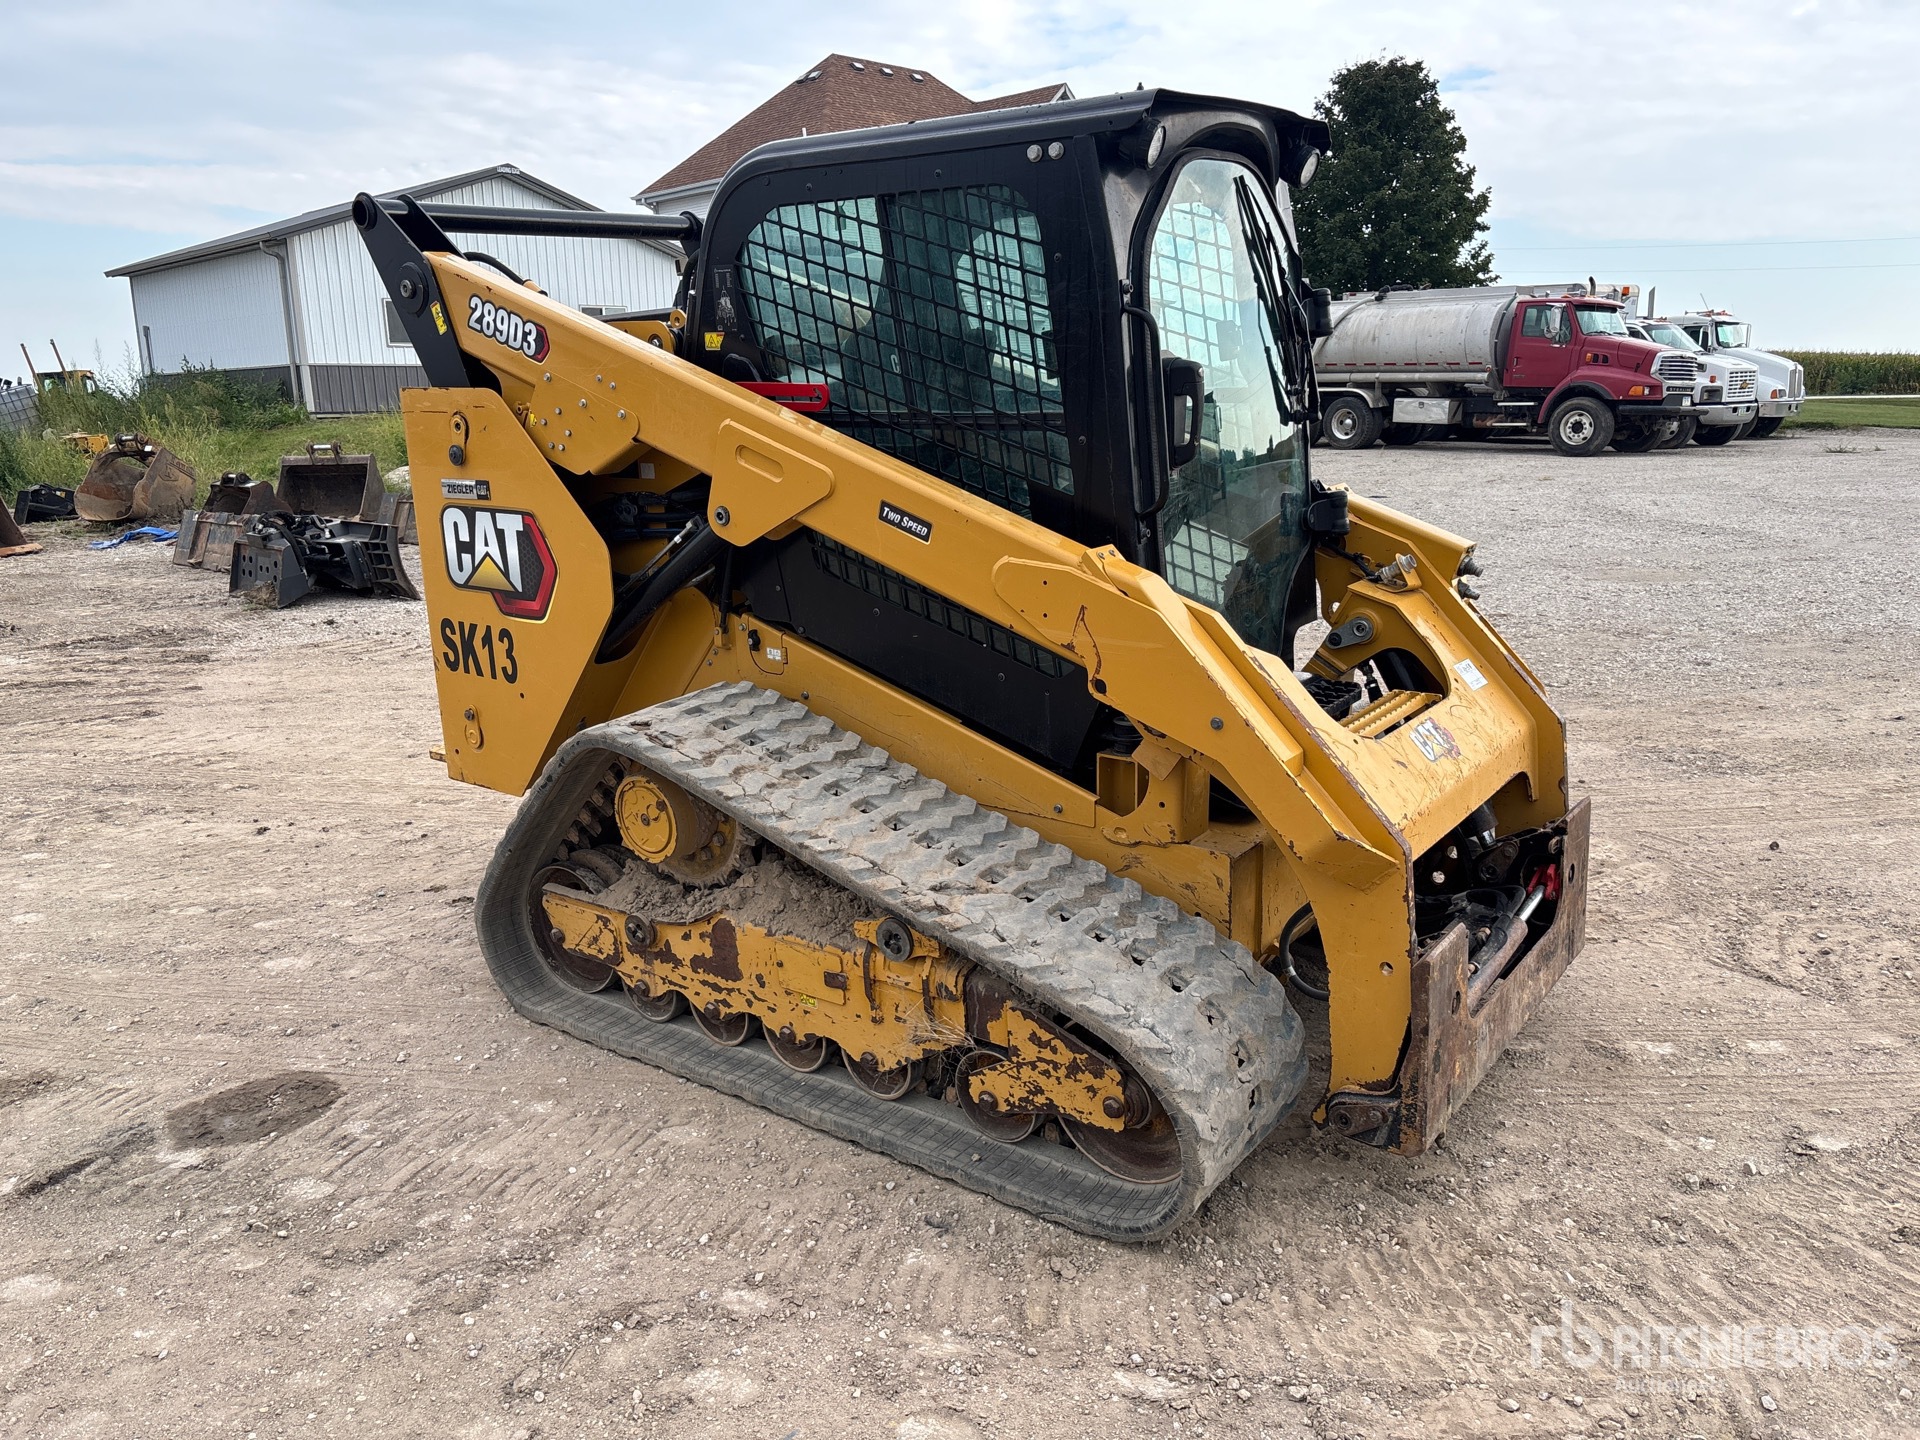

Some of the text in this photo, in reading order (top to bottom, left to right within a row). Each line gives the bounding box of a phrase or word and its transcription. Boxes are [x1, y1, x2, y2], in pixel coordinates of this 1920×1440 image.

[467, 296, 537, 356] 289D3
[446, 484, 487, 495] ZIEGLER CAT
[442, 507, 524, 593] CAT
[440, 617, 518, 685] SK13
[1409, 719, 1449, 761] CAT
